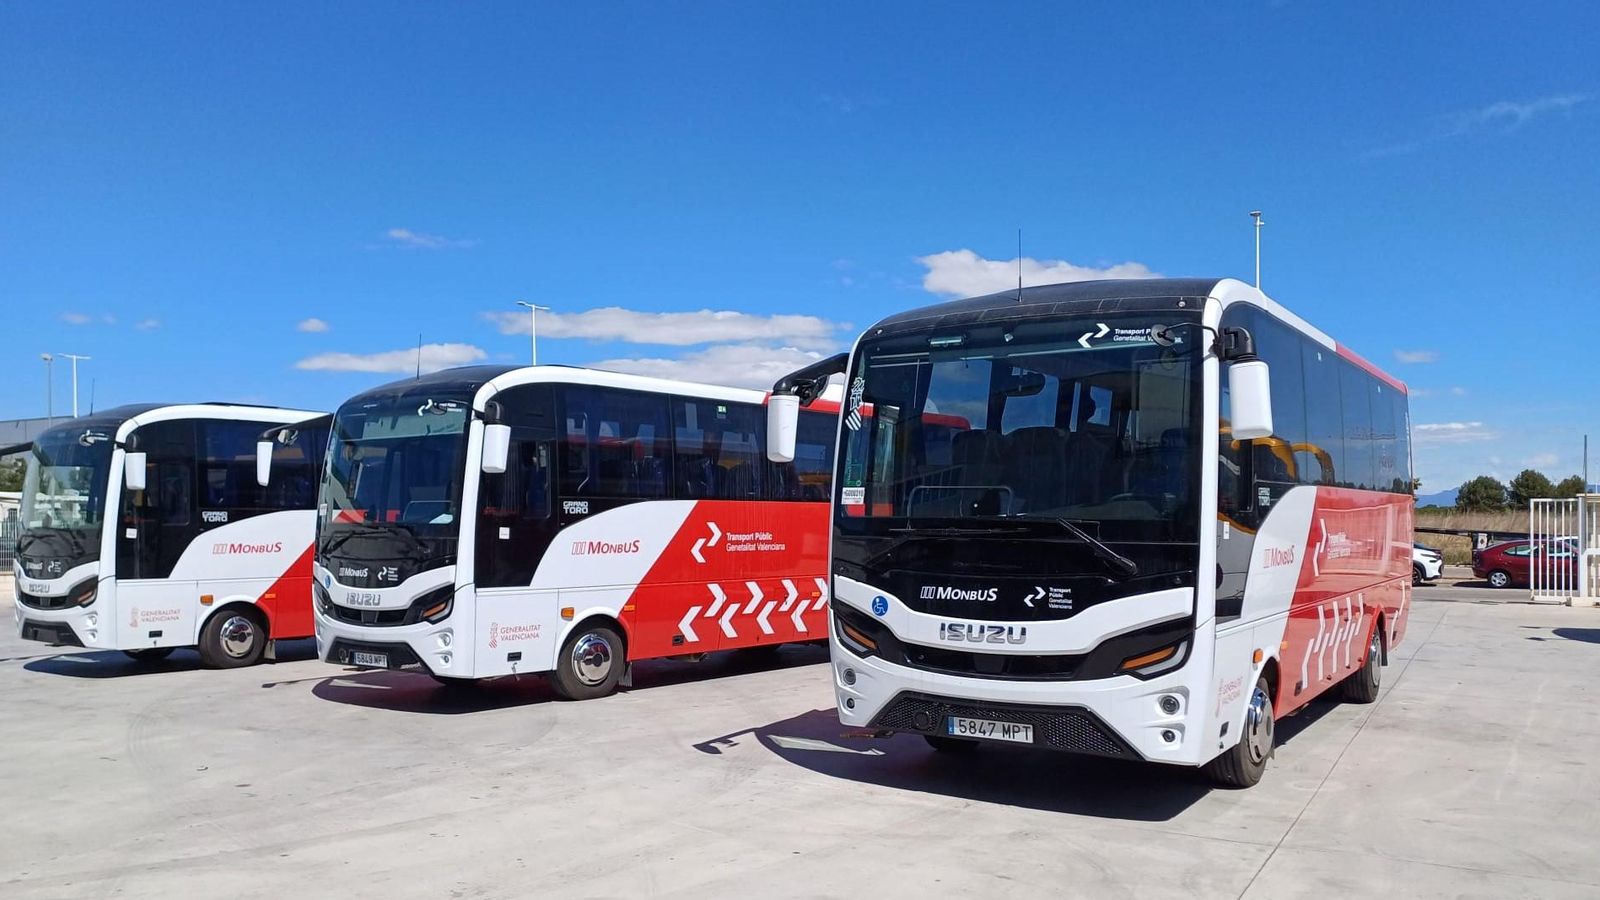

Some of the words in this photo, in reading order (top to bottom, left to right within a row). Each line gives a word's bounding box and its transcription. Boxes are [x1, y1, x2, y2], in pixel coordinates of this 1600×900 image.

[726, 532, 754, 542] Transport
[588, 540, 640, 554] MONBUS
[757, 543, 786, 551] Valenciana
[346, 592, 381, 606] ISUZU
[937, 587, 998, 601] MONBUS
[500, 624, 542, 634] GENERALITAT
[939, 622, 1027, 644] ISUZU
[500, 632, 540, 641] VALENCIANA
[958, 719, 996, 736] 5847
[1002, 723, 1031, 741] MPT
